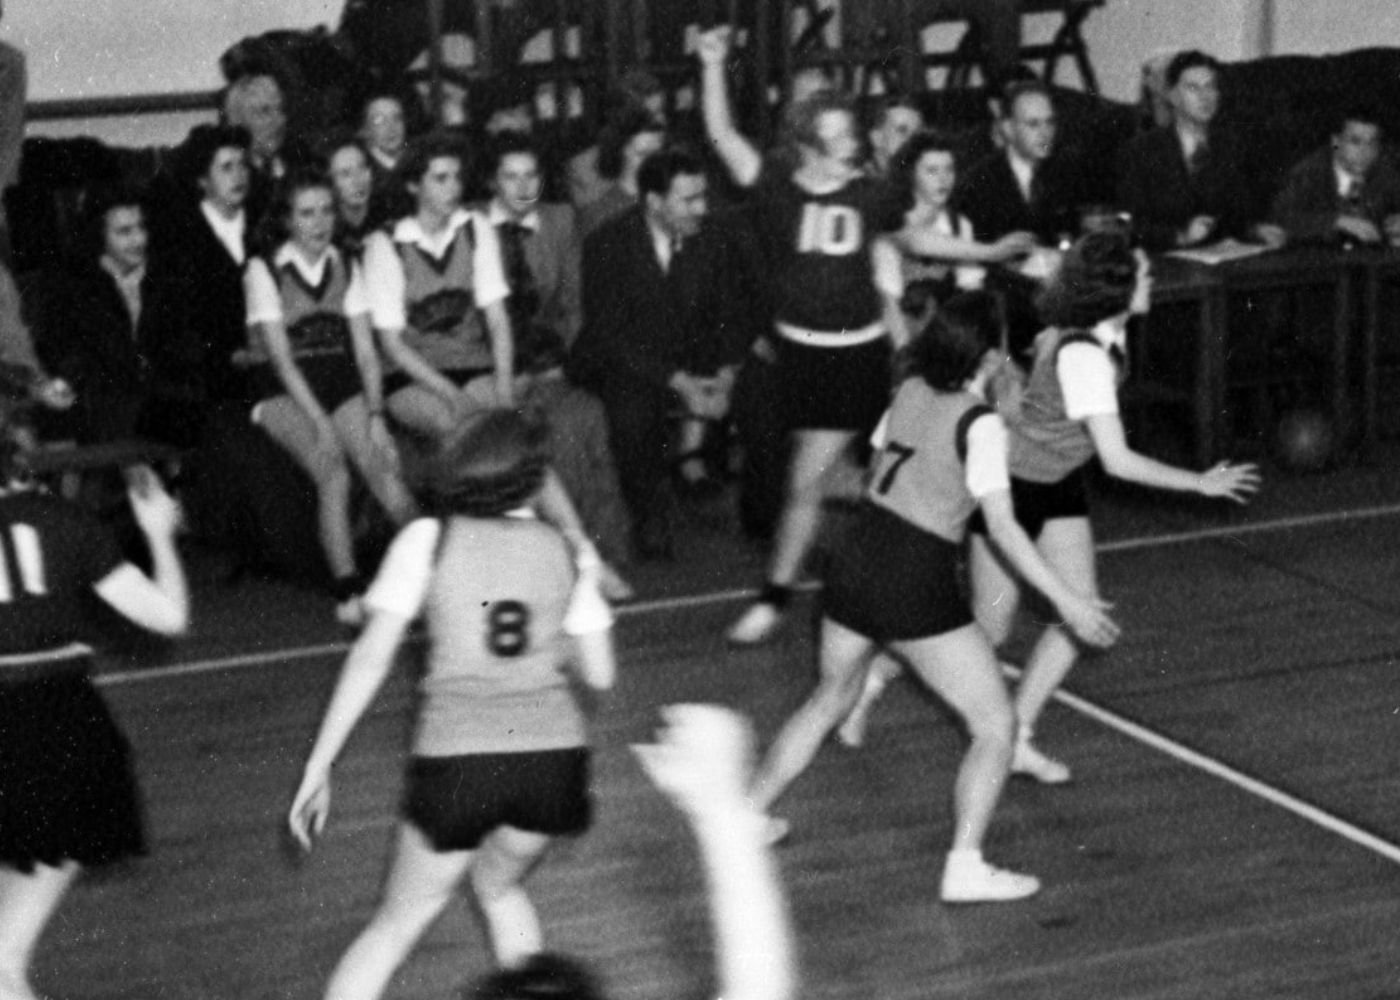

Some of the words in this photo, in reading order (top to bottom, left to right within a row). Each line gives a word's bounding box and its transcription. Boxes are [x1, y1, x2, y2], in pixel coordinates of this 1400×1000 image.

[797, 202, 863, 256] 10
[877, 441, 916, 496] 7
[485, 599, 532, 659] 8
